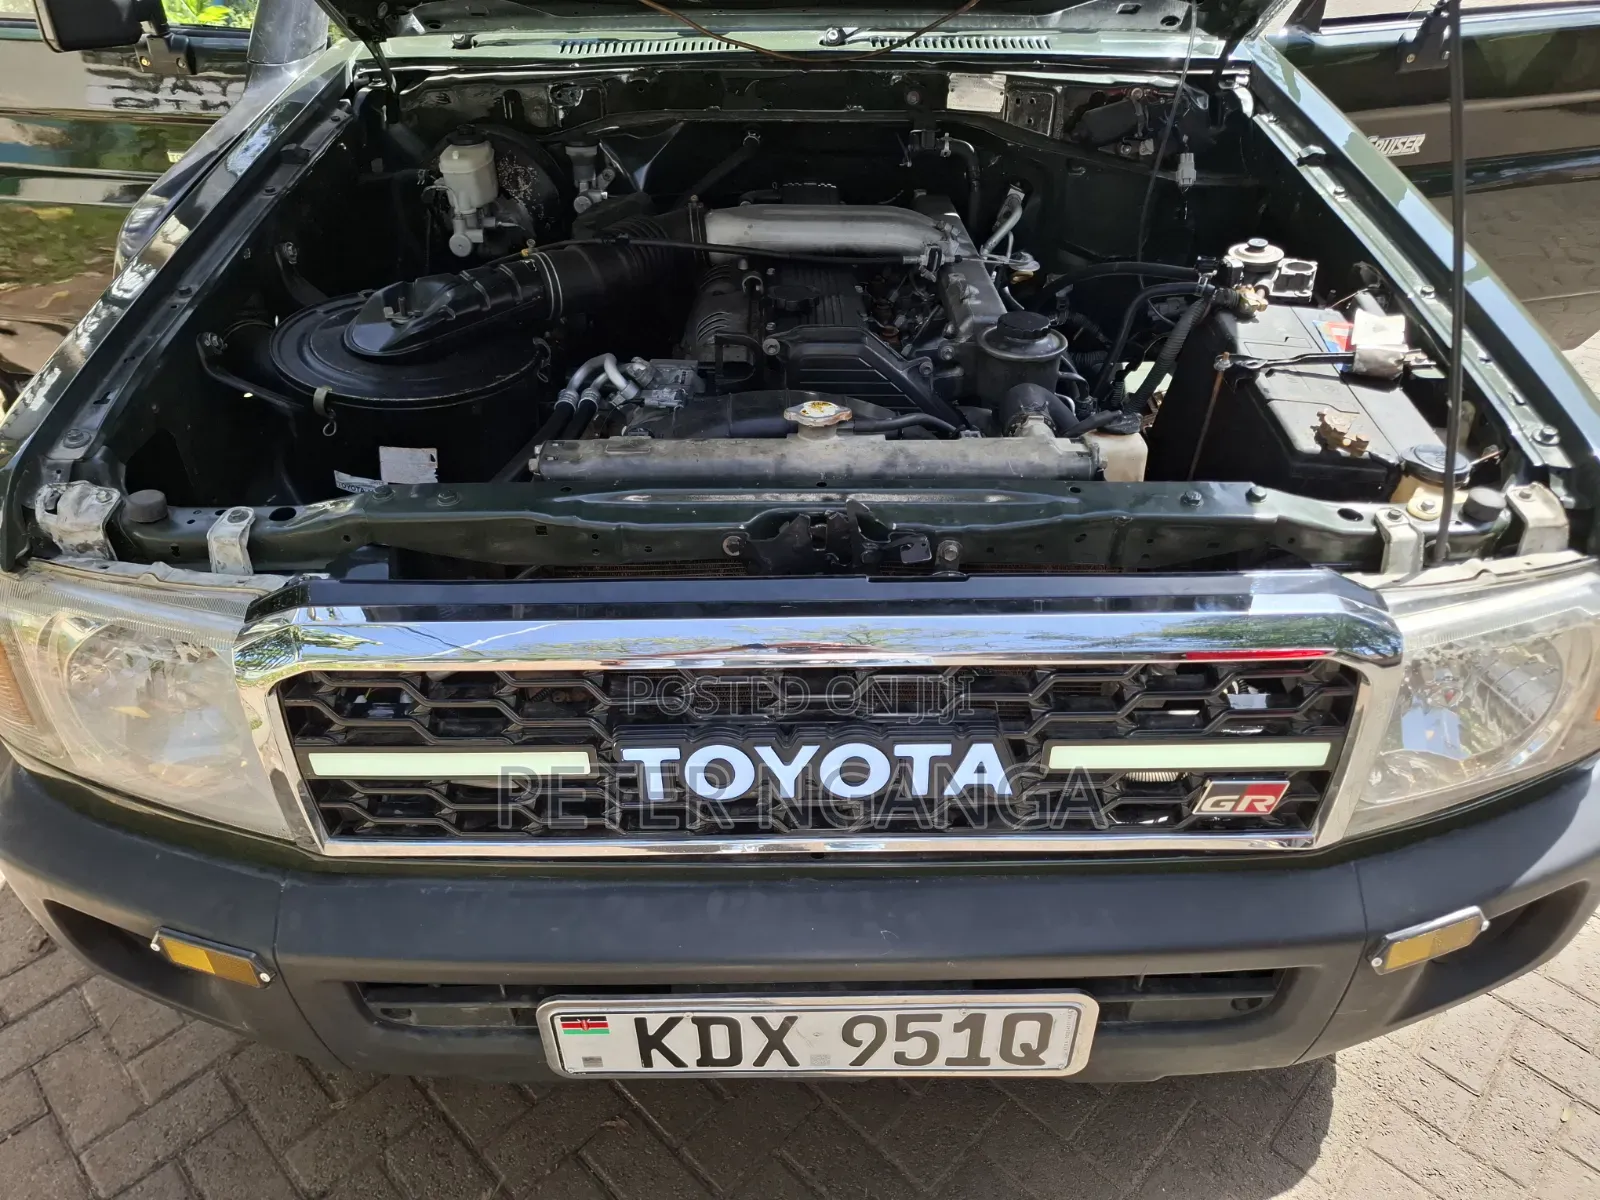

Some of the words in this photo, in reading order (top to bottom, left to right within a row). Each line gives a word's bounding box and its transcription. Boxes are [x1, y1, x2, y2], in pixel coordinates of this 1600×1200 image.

[622, 743, 1013, 800] TOYOTA
[1201, 795, 1276, 812] GR
[633, 1014, 801, 1069] KDX
[841, 1012, 1055, 1067] 951Q
